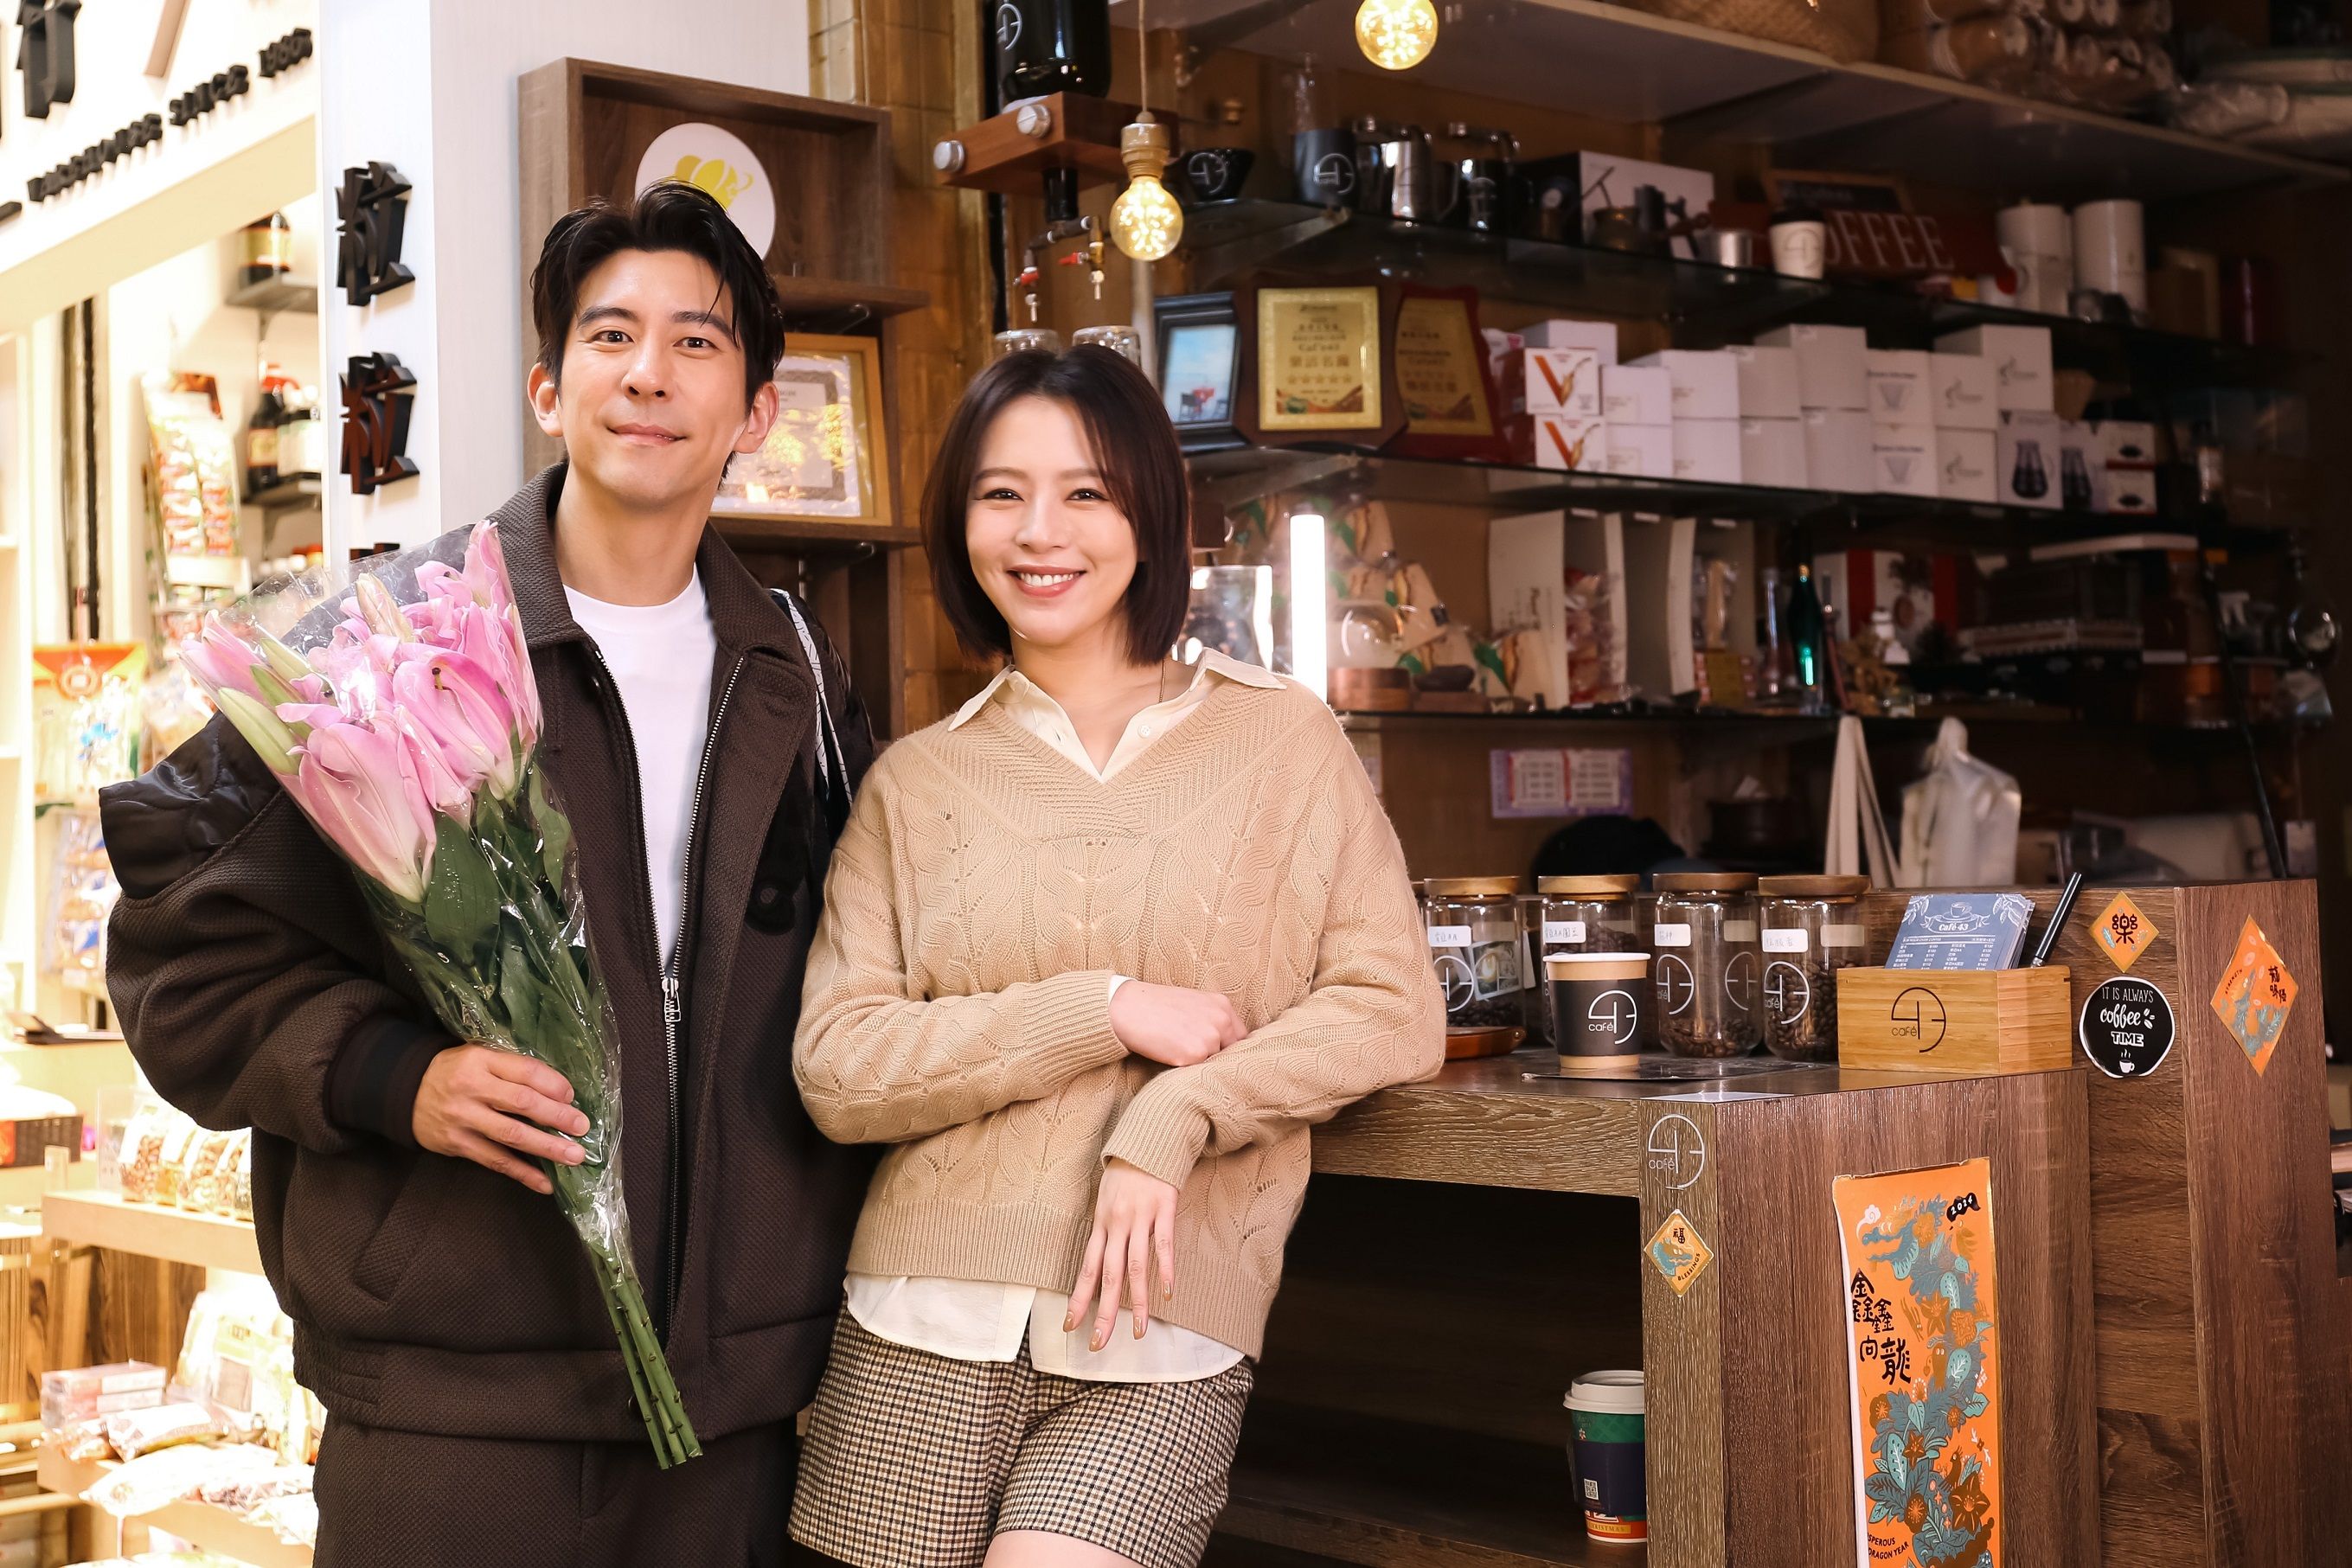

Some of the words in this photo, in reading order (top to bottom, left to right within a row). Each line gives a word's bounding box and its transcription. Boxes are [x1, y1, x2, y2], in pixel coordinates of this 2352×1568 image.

[1827, 210, 1956, 269] FFEE
[2112, 913, 2138, 944] 樂
[2225, 969, 2243, 995] STRENGTH
[2102, 987, 2109, 1000] IT
[2112, 987, 2120, 1001] IS
[2122, 989, 2154, 1003] ALWAYS
[2100, 1004, 2141, 1028] coffee
[1588, 1021, 1614, 1032] café
[1891, 1026, 1917, 1037] café
[2111, 1031, 2144, 1046] TIME
[1648, 1157, 1676, 1170] café
[1951, 1194, 1974, 1216] 2024
[1673, 1227, 1686, 1245] 福
[1677, 1252, 1701, 1282] BLESSINGS
[1868, 1532, 1896, 1547] SPEROUS
[1868, 1546, 1894, 1560] DRAGON
[1894, 1541, 1910, 1557] YEAR
